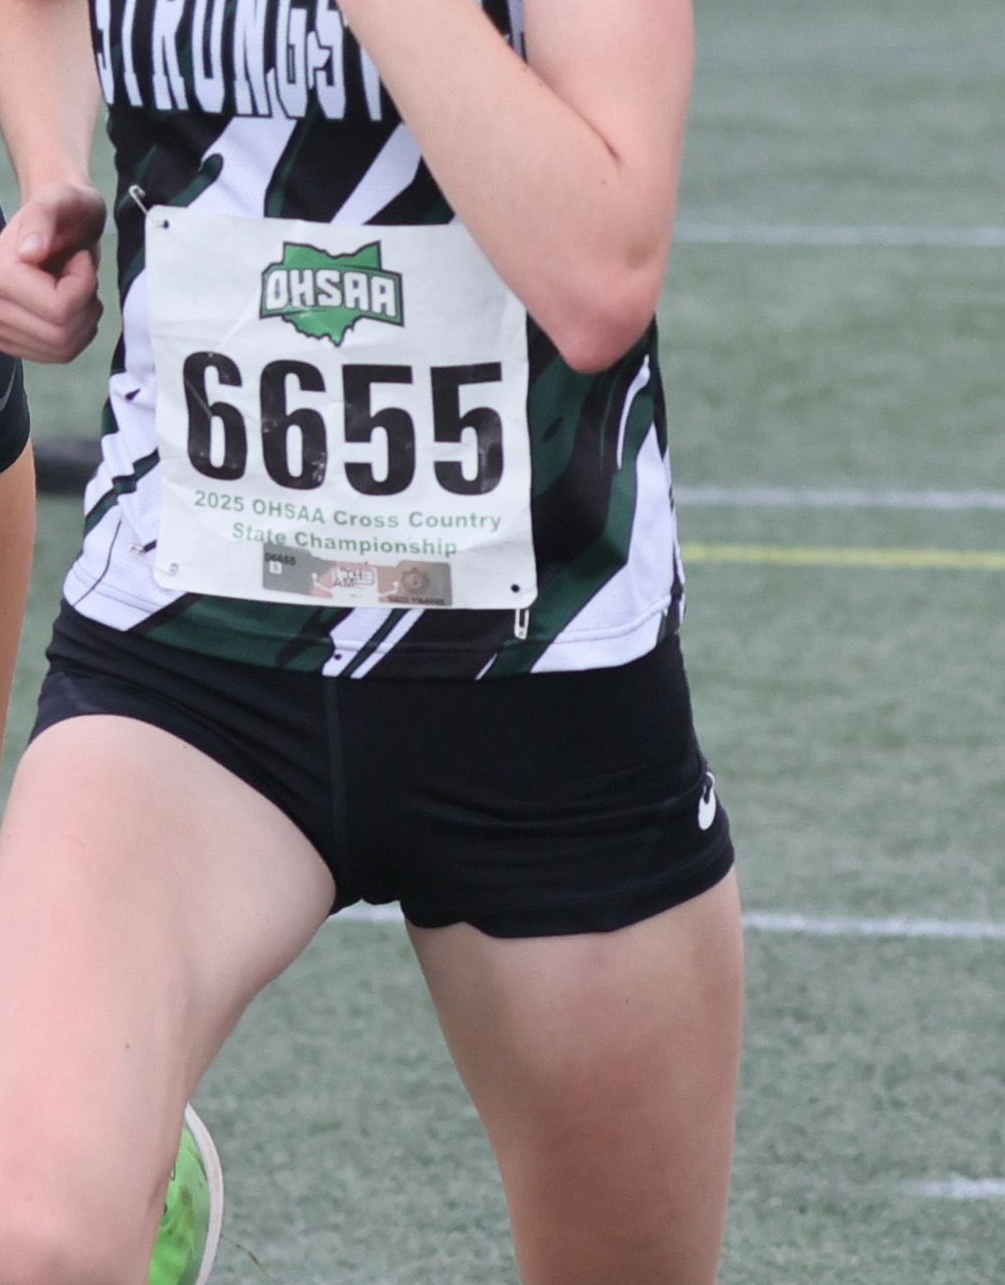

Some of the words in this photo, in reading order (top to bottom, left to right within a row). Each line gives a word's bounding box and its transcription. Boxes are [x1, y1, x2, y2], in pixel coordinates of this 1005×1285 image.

[265, 268, 398, 317] OHSAA
[182, 351, 504, 496] 6655
[194, 490, 244, 512] 2025
[252, 499, 325, 524] OHSAA
[333, 510, 399, 529] Cross
[409, 511, 501, 532] Country
[232, 522, 287, 546] State
[295, 531, 457, 558] Championship
